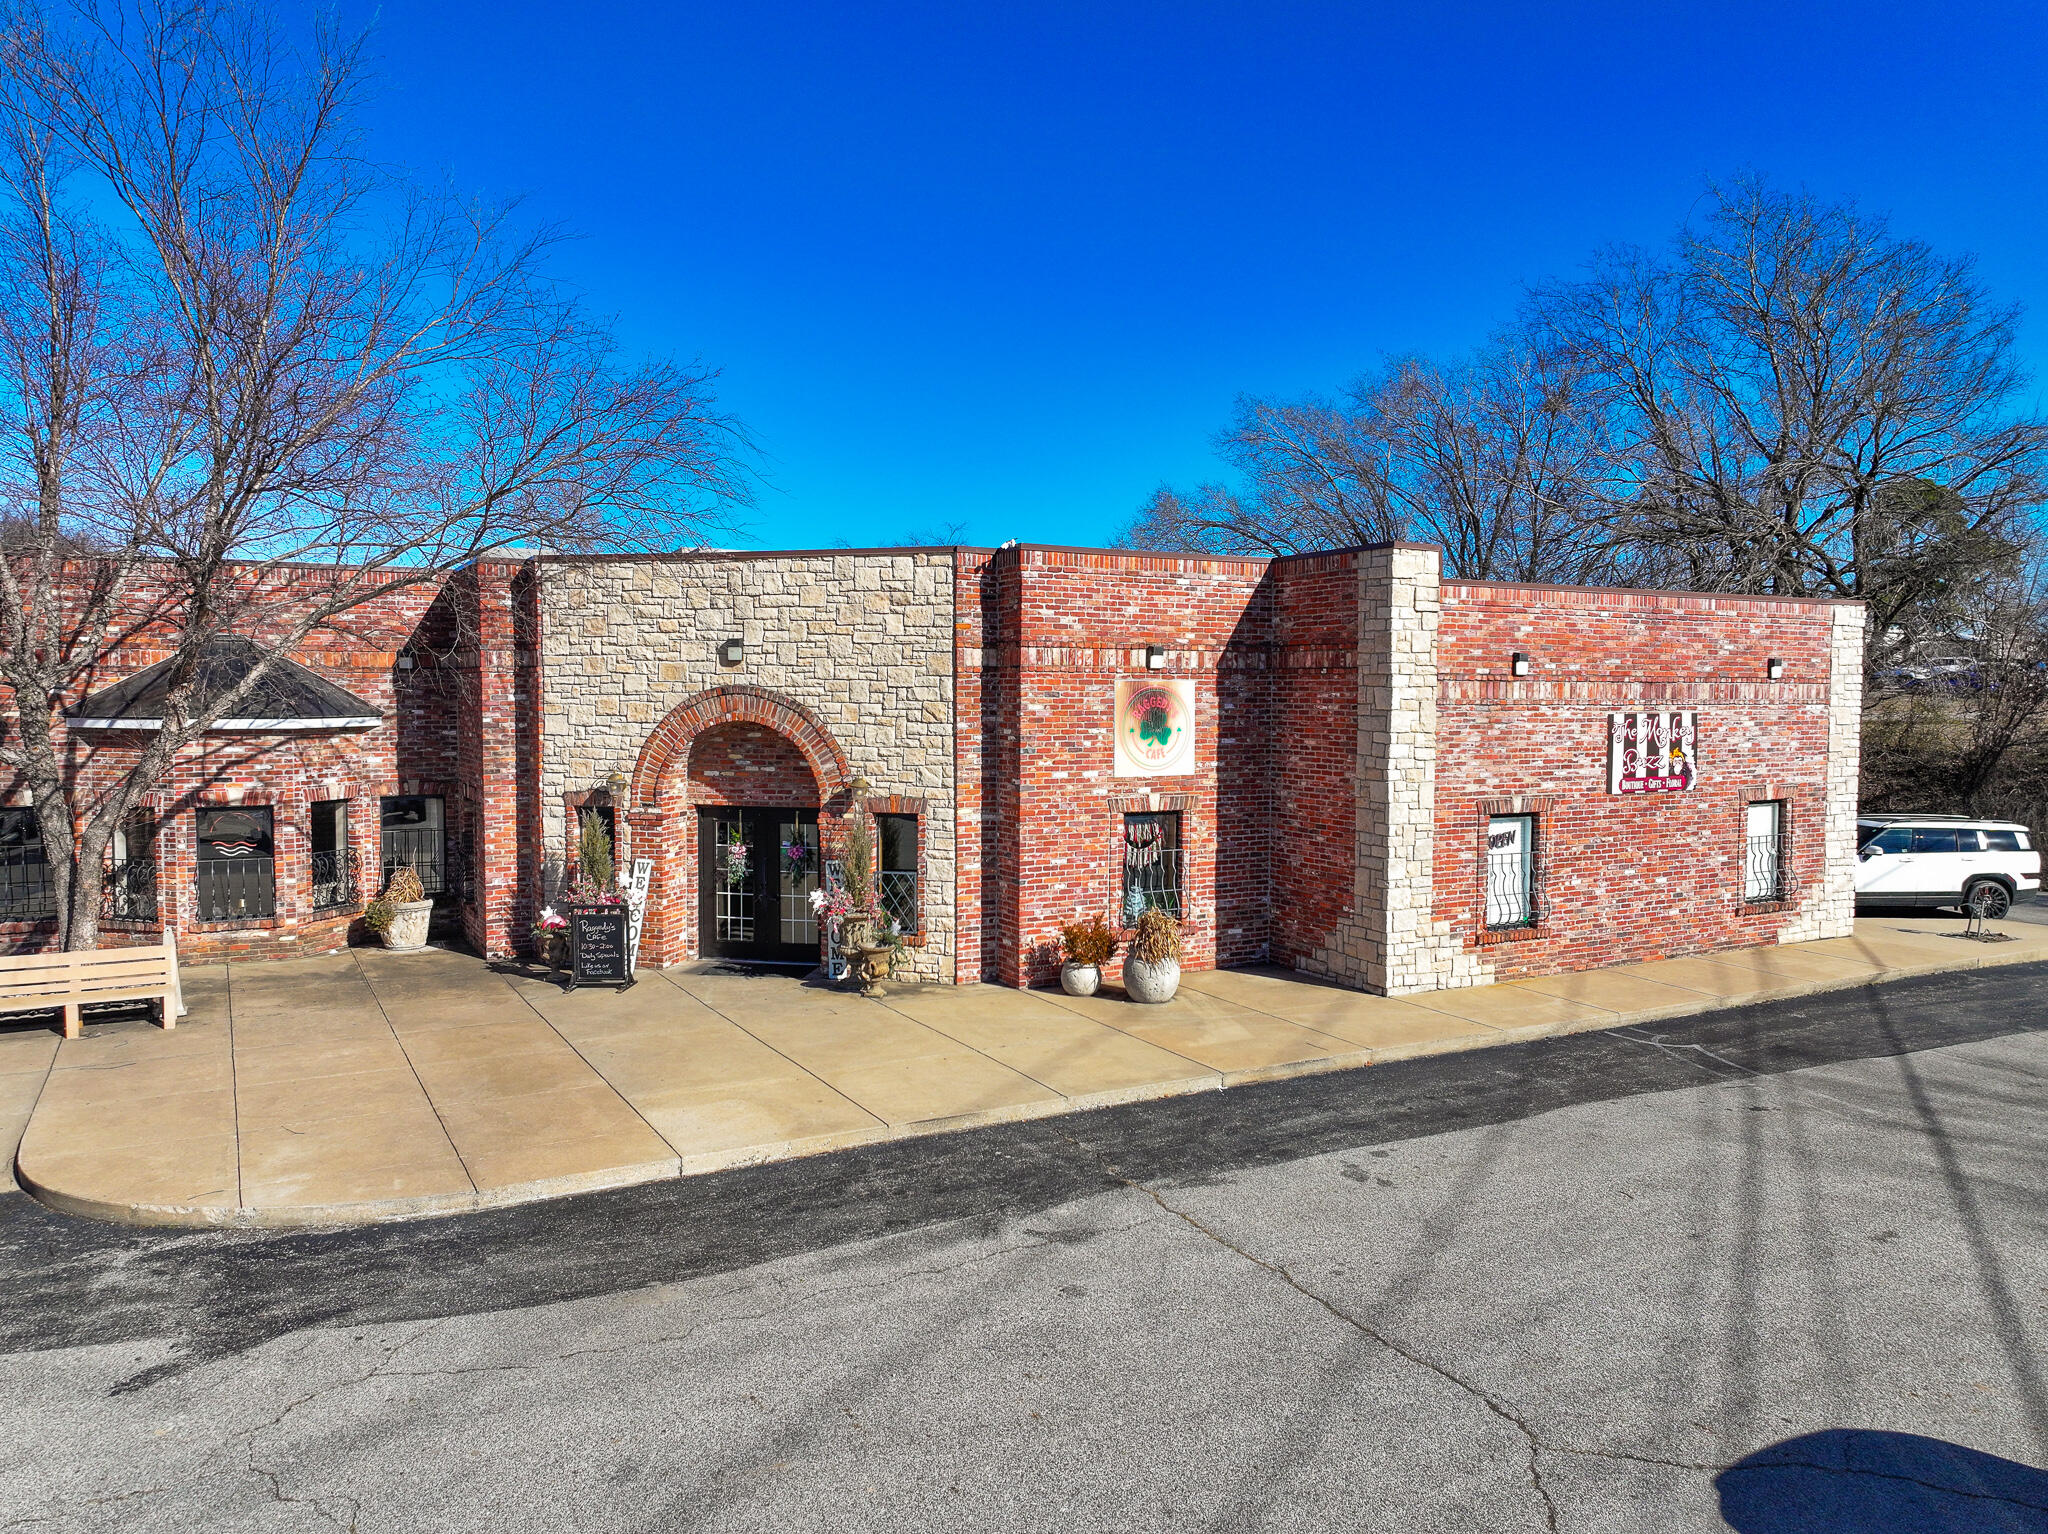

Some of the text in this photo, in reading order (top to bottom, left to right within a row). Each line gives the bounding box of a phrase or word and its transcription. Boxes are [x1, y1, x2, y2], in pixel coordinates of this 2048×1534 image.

[1611, 715, 1695, 748] The Monkey
[1622, 748, 1666, 774] Buzz
[1488, 829, 1516, 850] OPEN
